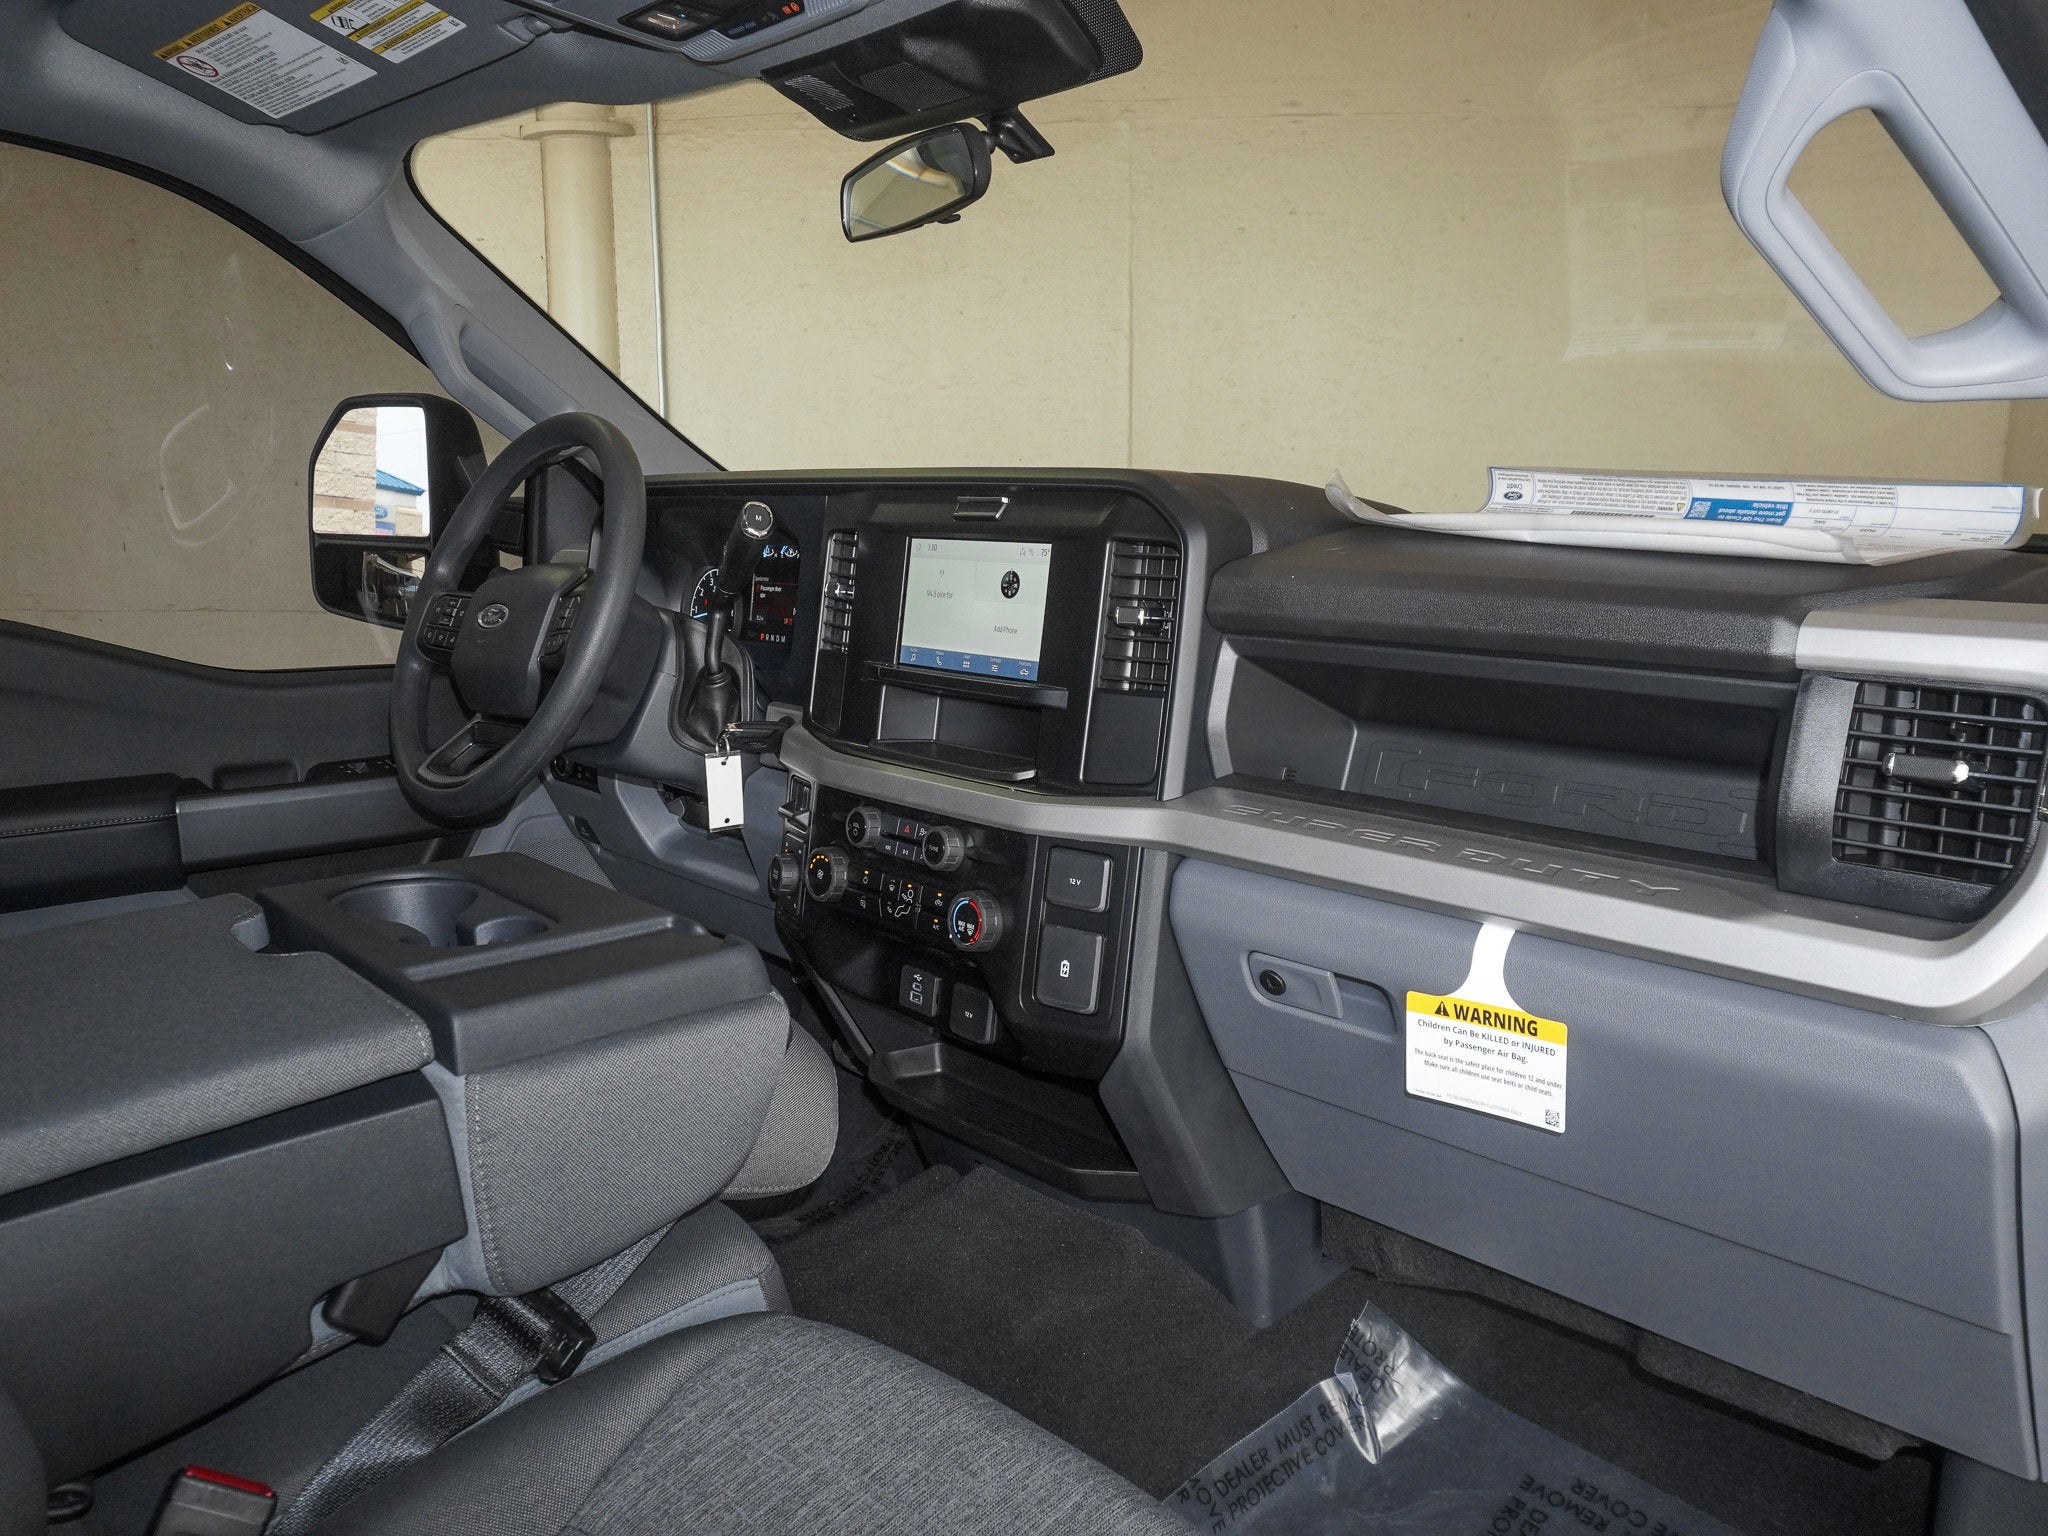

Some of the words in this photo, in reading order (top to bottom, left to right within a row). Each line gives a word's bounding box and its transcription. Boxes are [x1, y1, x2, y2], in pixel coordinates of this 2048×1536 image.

[1222, 803, 1442, 852] SUPER
[1455, 847, 1681, 896] DUTY
[1417, 1018, 1451, 1032] Children
[1452, 1026, 1468, 1036] Can
[1470, 1029, 1480, 1039] Be
[1481, 1032, 1509, 1045] KILLED
[1511, 1039, 1520, 1047] or
[1521, 1041, 1556, 1057] INJURED
[1454, 1003, 1538, 1037] WARNING
[1414, 1047, 1424, 1055] The
[1424, 1050, 1436, 1059] back
[1437, 1053, 1448, 1062] seat
[1455, 1057, 1464, 1065] the
[1465, 1058, 1480, 1069] safest
[1481, 1062, 1495, 1073] place
[1496, 1066, 1504, 1074] for
[1505, 1068, 1526, 1080] children
[1535, 1076, 1546, 1085] and
[1546, 1078, 1563, 1090] under.
[1443, 1037, 1453, 1047] by
[1455, 1040, 1495, 1056] Passenger
[1497, 1049, 1508, 1058] Air
[1511, 1052, 1528, 1064] Bag.
[1424, 1060, 1438, 1069] Make
[1439, 1064, 1450, 1072] sure
[1459, 1068, 1480, 1080] children
[1481, 1073, 1490, 1081] use
[1491, 1075, 1503, 1085] seat
[1503, 1077, 1516, 1087] belts
[1524, 1083, 1537, 1093] child
[1538, 1088, 1554, 1098] seats.
[1213, 1447, 1272, 1498] DEALER
[1273, 1415, 1317, 1454] MUST
[1228, 1446, 1314, 1521] PROTECTIVE
